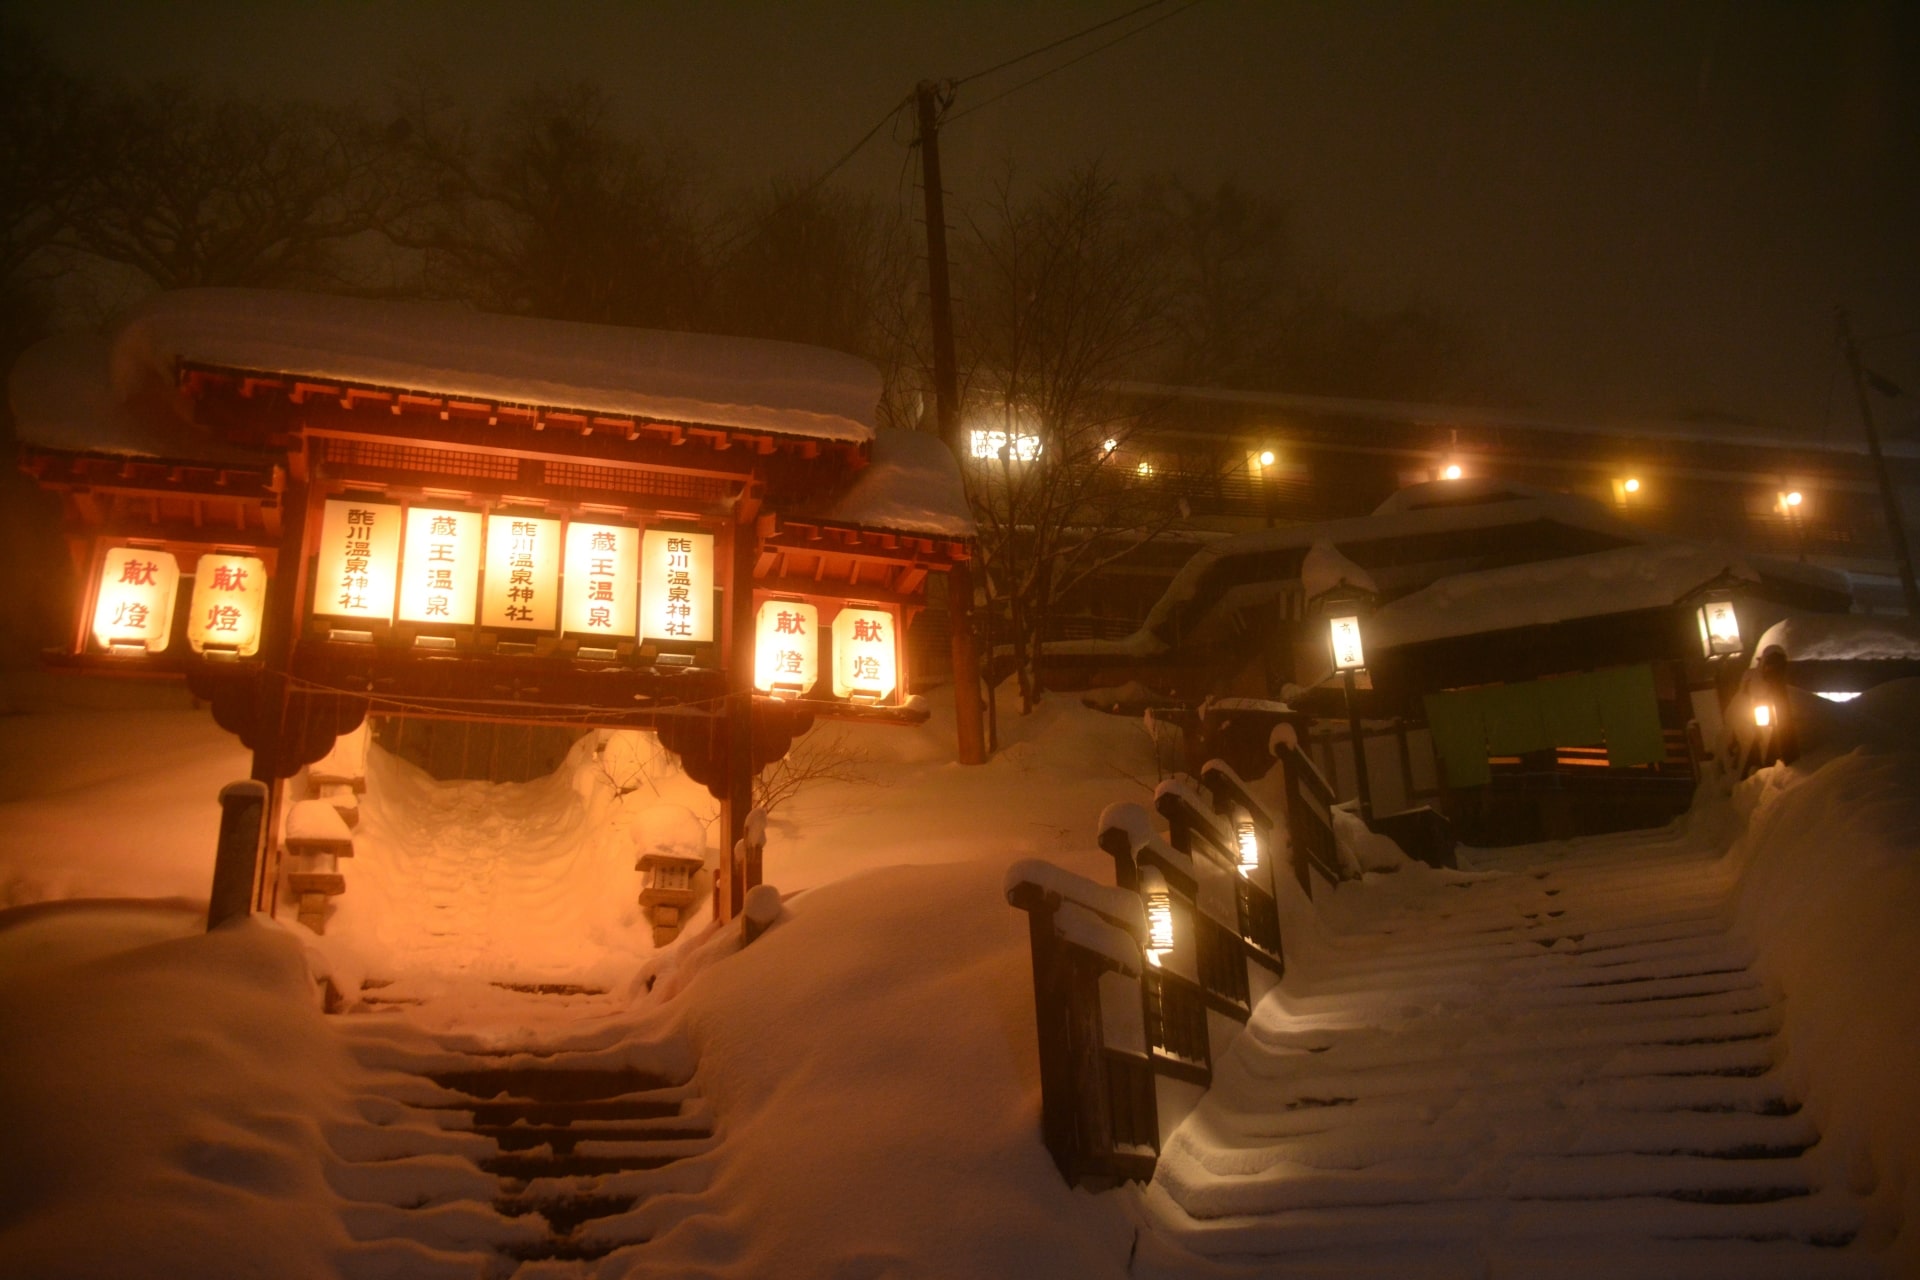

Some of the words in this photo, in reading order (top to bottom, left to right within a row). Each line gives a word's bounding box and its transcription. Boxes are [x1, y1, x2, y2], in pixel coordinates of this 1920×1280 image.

[112, 559, 158, 629] 献燈
[205, 565, 248, 632] 献燈
[338, 508, 376, 609] 酢川温泉神社
[425, 515, 457, 616] 蔵王温泉
[504, 521, 537, 622] 酢川温泉神社
[588, 531, 617, 628] 蔵王温泉
[665, 537, 692, 636] 酢川温泉神社
[774, 610, 807, 674] 献燈
[852, 618, 882, 680] 献燈
